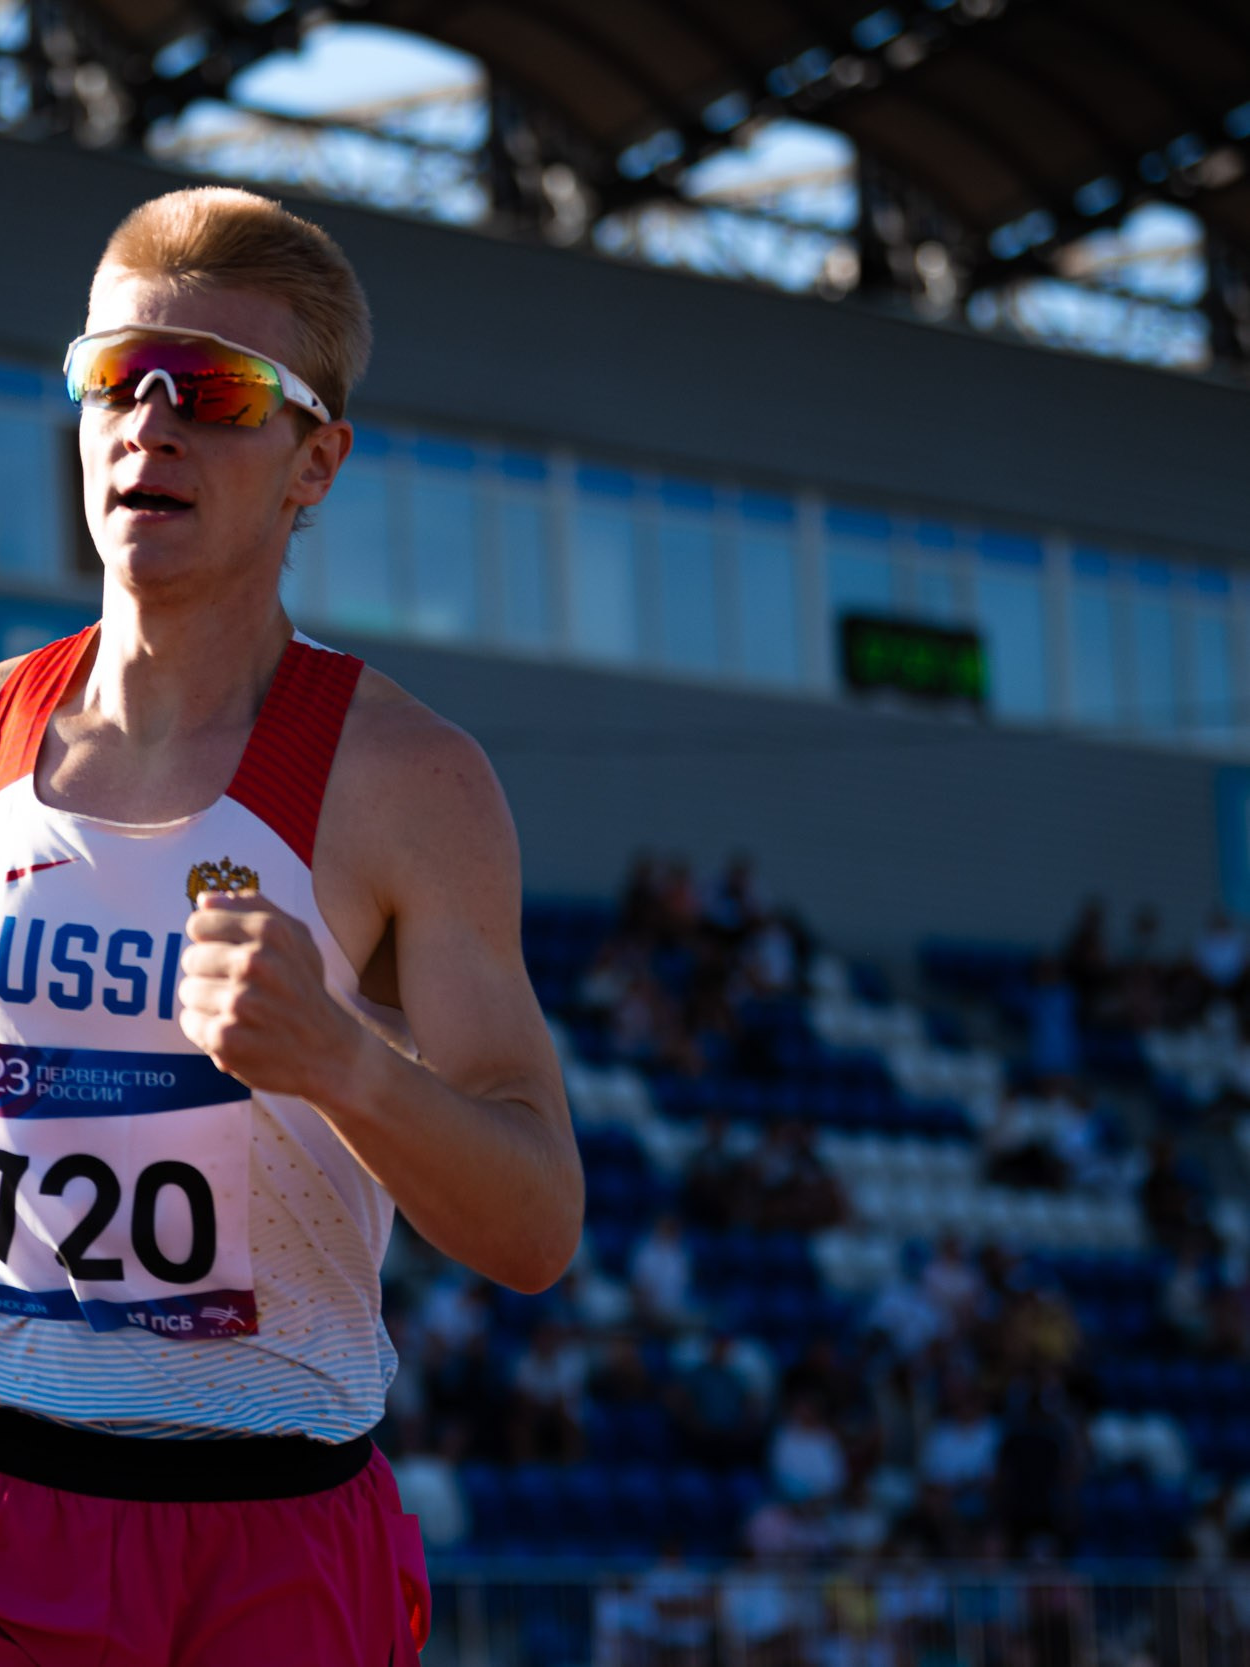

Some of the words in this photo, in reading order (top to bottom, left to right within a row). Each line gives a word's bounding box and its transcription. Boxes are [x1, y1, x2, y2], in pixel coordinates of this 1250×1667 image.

[36, 1065, 176, 1087] ПЕРВЕНСТВО
[36, 1083, 123, 1101] РОССИИ
[150, 1314, 194, 1331] ПСБ
